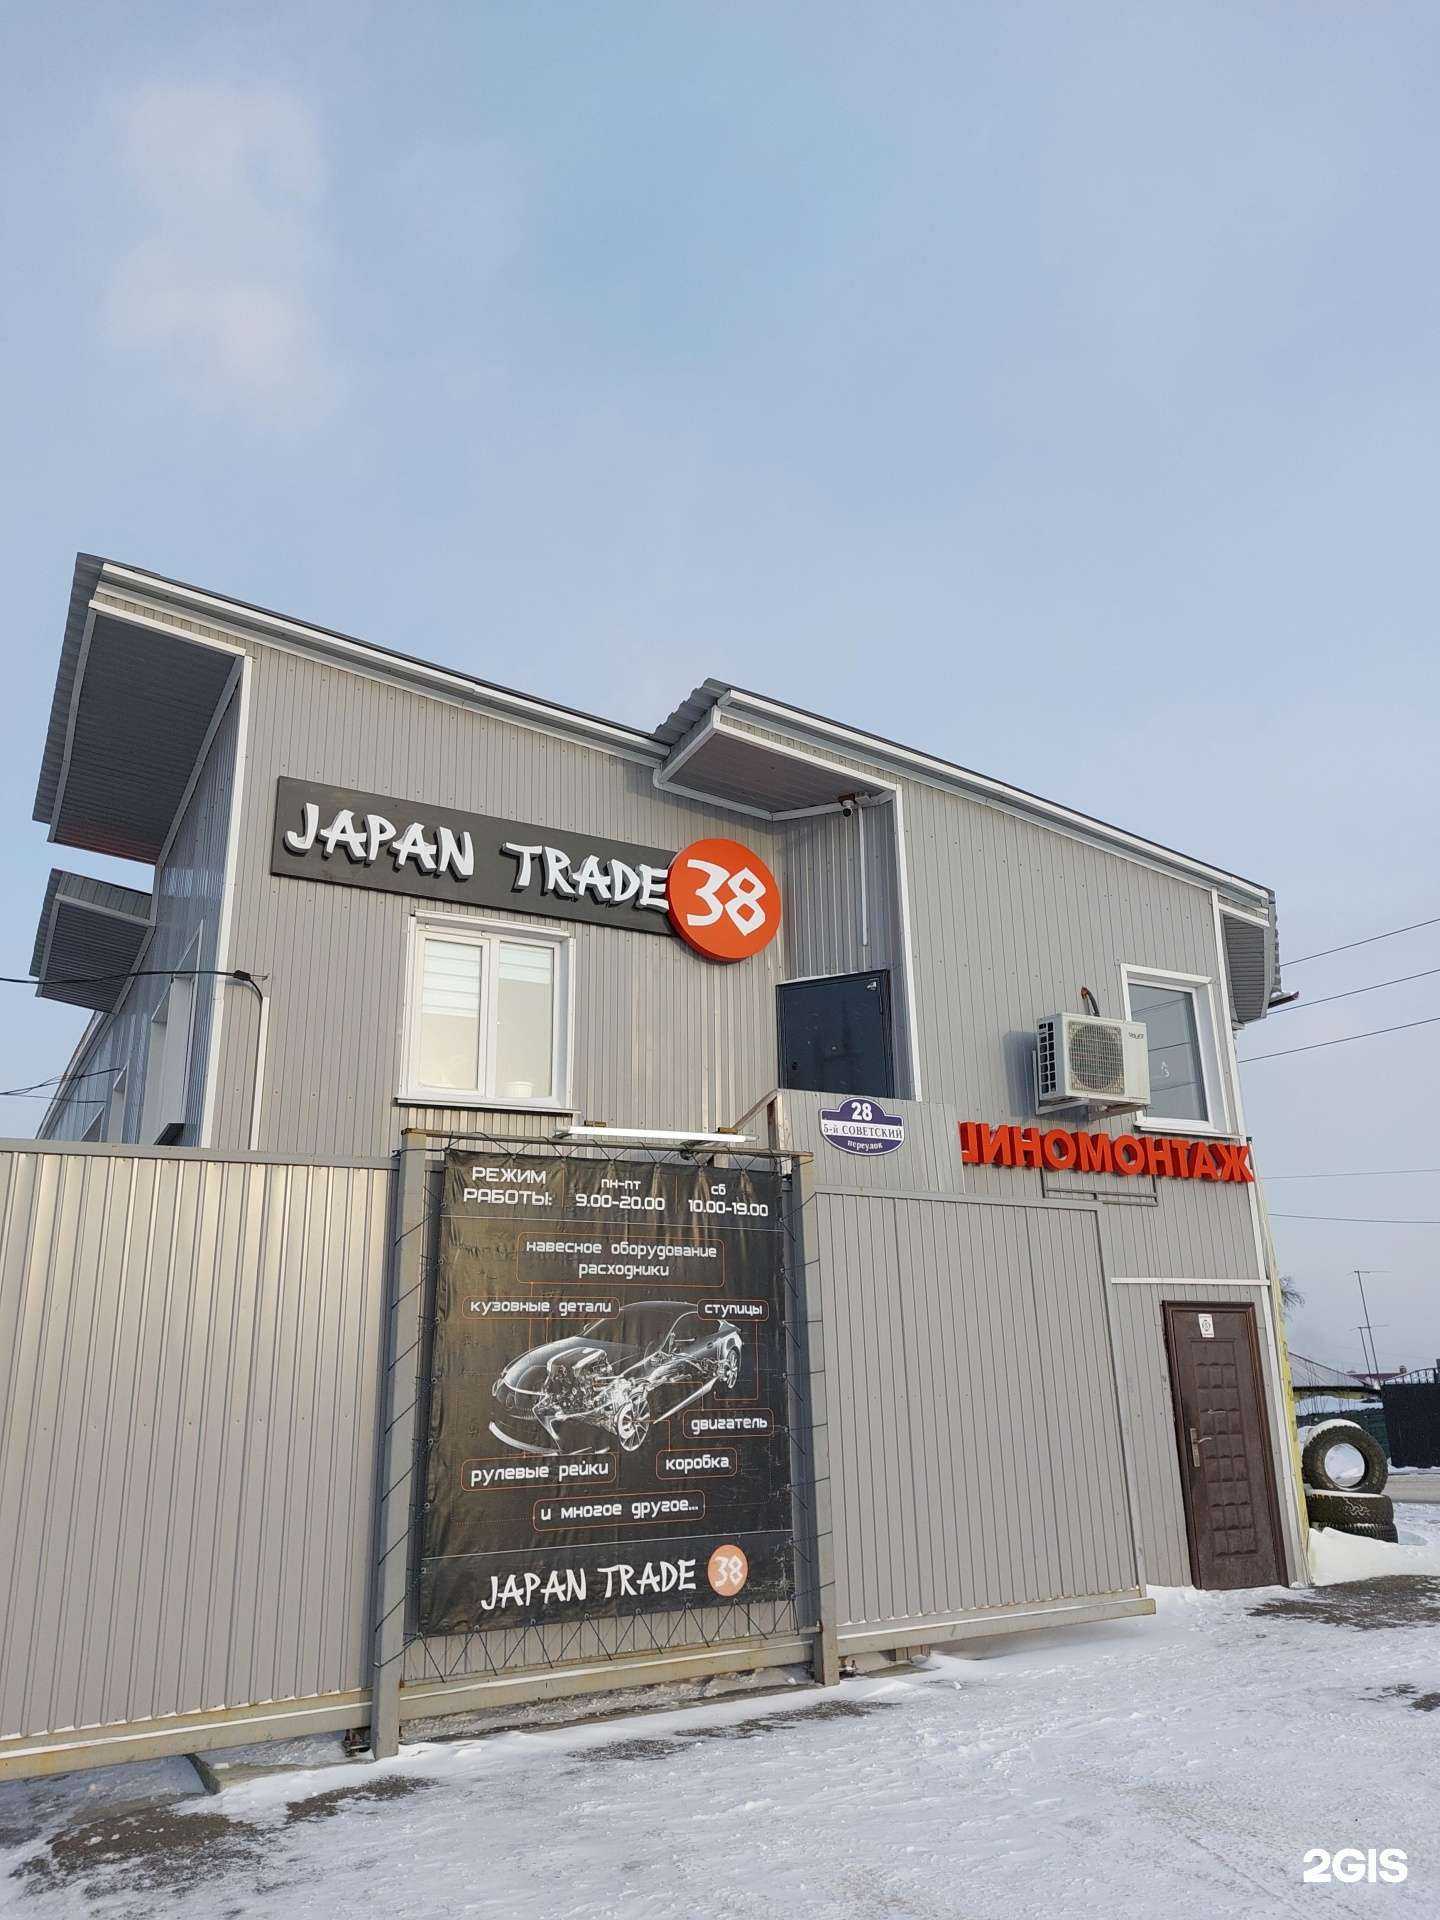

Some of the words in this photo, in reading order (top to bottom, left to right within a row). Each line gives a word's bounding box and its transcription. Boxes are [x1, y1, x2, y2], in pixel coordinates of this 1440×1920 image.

[283, 802, 476, 880] JAPAN
[502, 841, 670, 912] TRADE
[686, 858, 767, 936] 38
[852, 1102, 872, 1121] 28
[842, 1125, 902, 1138] СОВЕТСКИЙ
[847, 1139, 883, 1151] переулок
[472, 1166, 547, 1185] РЕЖИМ
[601, 1178, 641, 1191] пн-пт
[463, 1189, 552, 1207] РАБОТЫ:
[711, 1183, 727, 1196] сб
[576, 1193, 666, 1212] 9.00-20.00
[688, 1199, 769, 1217] 10.00-19.00
[526, 1239, 602, 1255] навесное
[611, 1240, 717, 1260] оборудование
[578, 1262, 670, 1279] расходники
[470, 1300, 550, 1314] кузовные
[558, 1301, 612, 1317] детали
[704, 1303, 764, 1319] ступицы
[691, 1416, 769, 1435] двигатель
[470, 1465, 549, 1487] рулевые
[558, 1459, 609, 1482] рейки
[665, 1454, 729, 1474] коробка
[540, 1509, 551, 1521] и
[560, 1502, 622, 1520] многое
[480, 1568, 587, 1611] JAPAN
[597, 1558, 697, 1599] TRADE
[713, 1555, 743, 1588] 38
